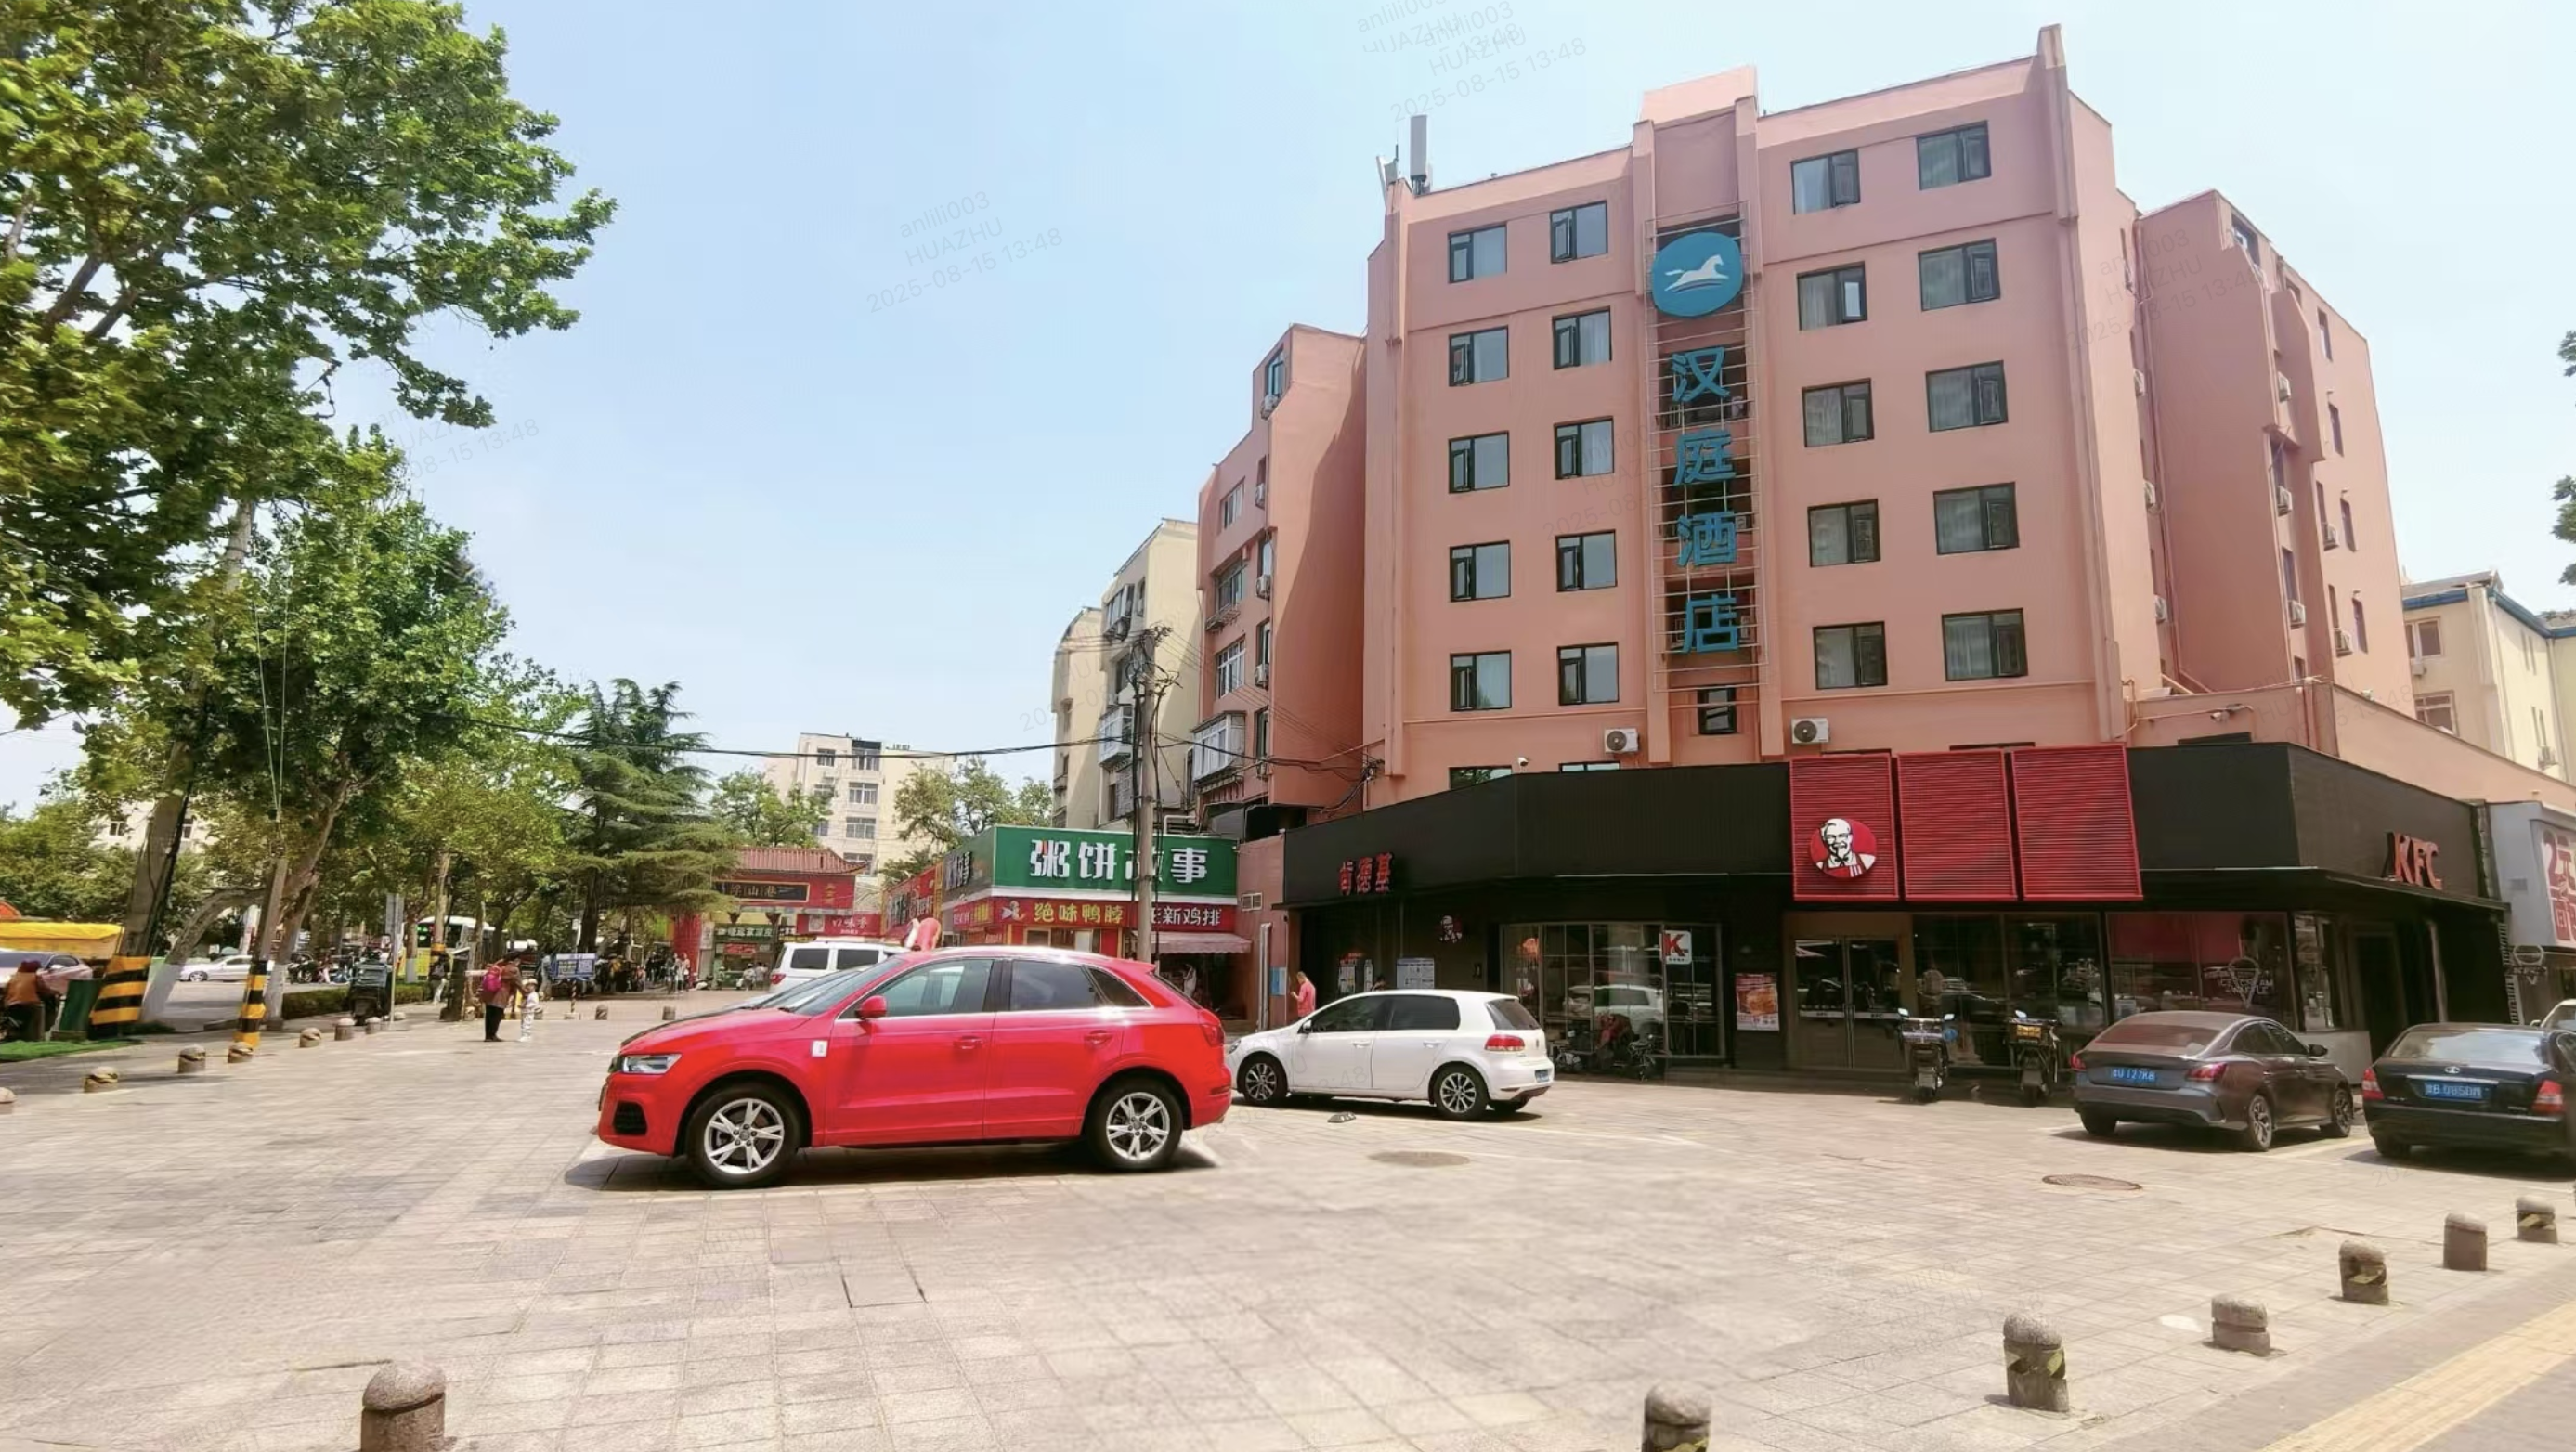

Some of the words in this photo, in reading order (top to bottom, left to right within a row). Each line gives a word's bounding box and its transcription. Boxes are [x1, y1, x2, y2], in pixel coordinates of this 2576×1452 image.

[1671, 347, 1740, 655] 汉庭酒店
[1339, 852, 1392, 896] 肯德基
[2393, 831, 2443, 890] KFC
[1034, 902, 1125, 924] 绝味鸭脖
